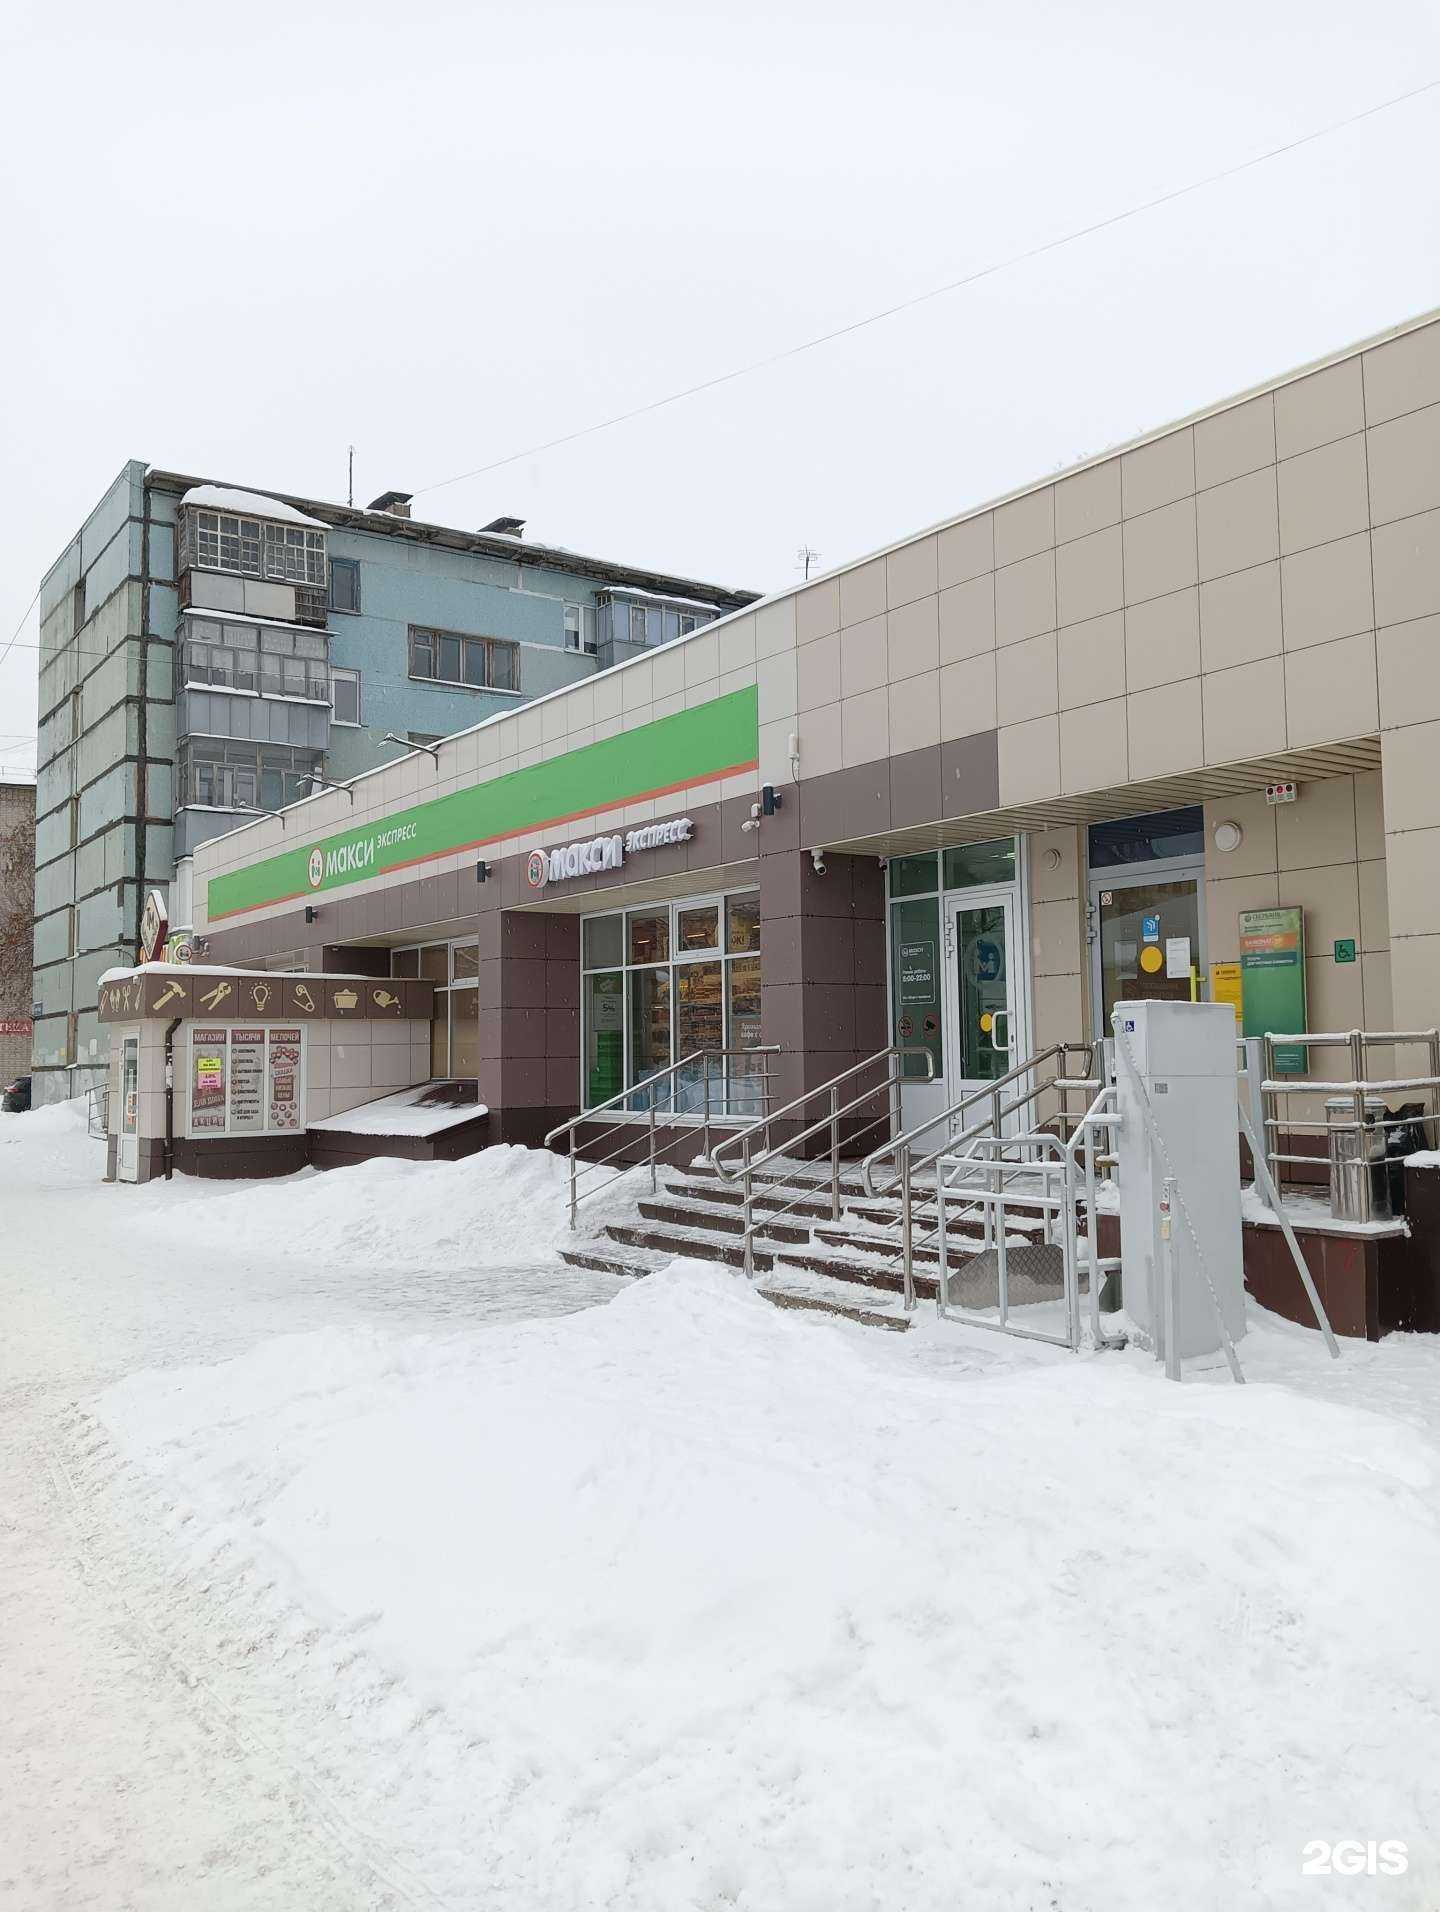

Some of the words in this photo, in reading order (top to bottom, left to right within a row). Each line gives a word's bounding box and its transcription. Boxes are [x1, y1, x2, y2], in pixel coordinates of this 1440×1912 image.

[376, 822, 417, 849] ЭКСПРЕСС
[625, 818, 692, 853] ЭКСПРЕСС
[194, 1033, 225, 1042] МАГАЗИН
[270, 1033, 299, 1042] МЕЛОЧЕЙ
